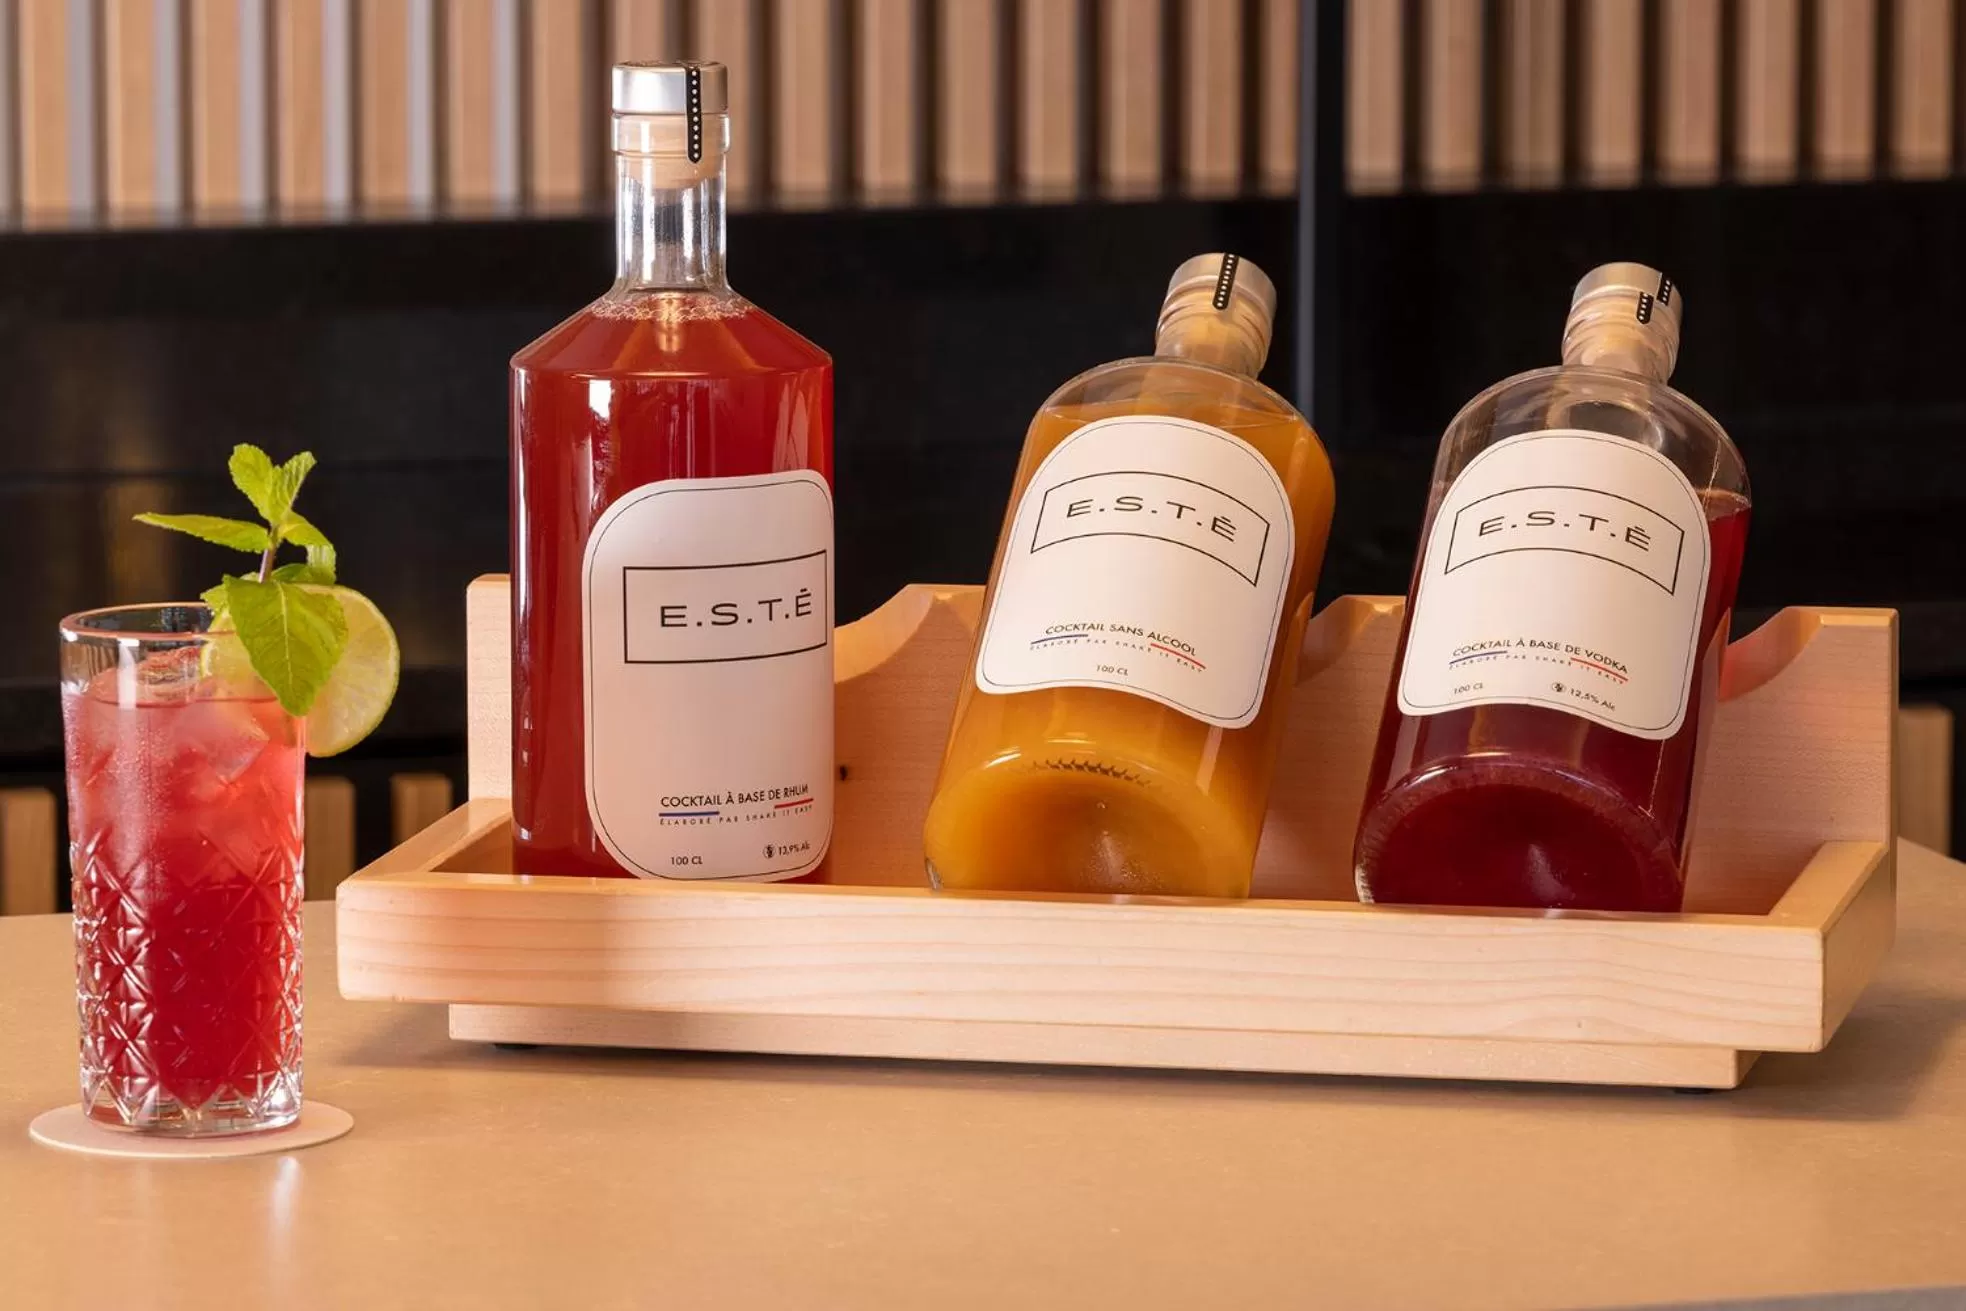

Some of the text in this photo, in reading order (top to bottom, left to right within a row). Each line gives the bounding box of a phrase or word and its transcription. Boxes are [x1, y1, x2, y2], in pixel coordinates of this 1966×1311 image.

[1066, 495, 1237, 543] E.S.T.É
[1478, 510, 1651, 552] E.S.T.É
[660, 588, 812, 628] E.S.T.É
[1045, 623, 1197, 656] COCKTAIL SANS ALCOOL
[1452, 637, 1628, 674] COCKTAIL À BASE DE VODKA
[1096, 664, 1114, 673] 100
[1453, 684, 1470, 695] 100
[660, 784, 809, 807] COCKTAIL À BASE DE RHUM
[671, 856, 703, 865] 100 CL
